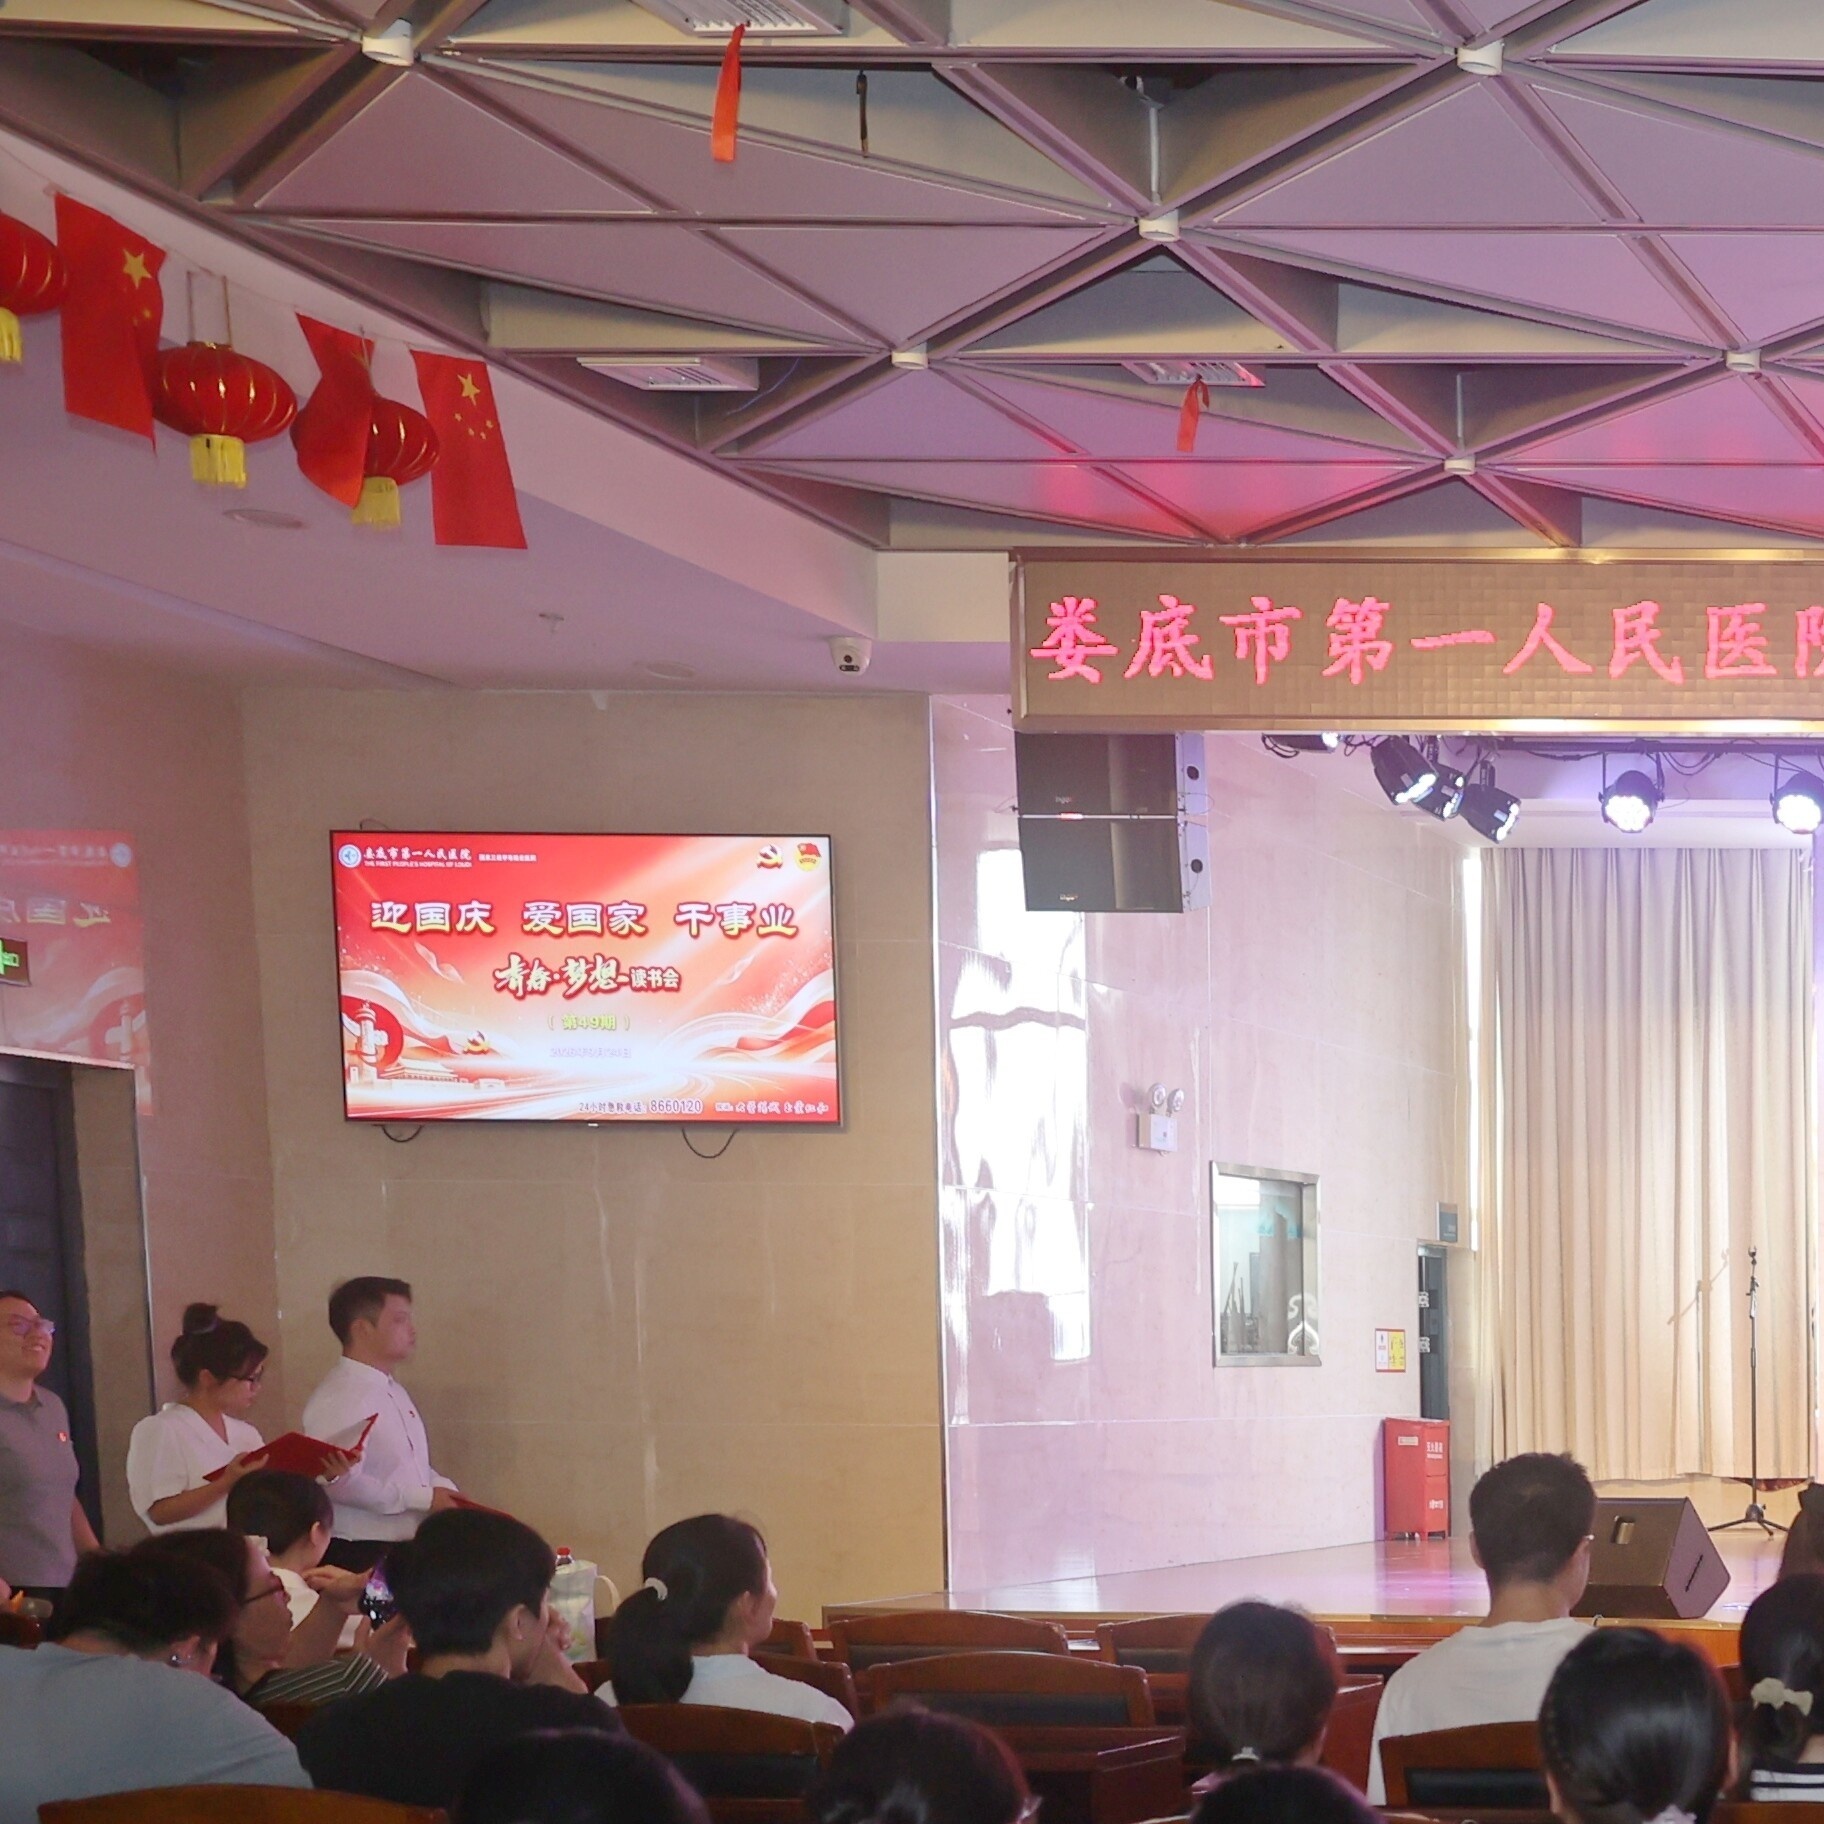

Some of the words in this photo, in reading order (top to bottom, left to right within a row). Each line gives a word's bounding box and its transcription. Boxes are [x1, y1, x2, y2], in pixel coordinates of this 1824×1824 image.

[370, 900, 495, 937] 迎国庆
[522, 900, 648, 938] 爱国家
[675, 901, 800, 938] 干事业
[650, 1100, 702, 1113] 8660120
